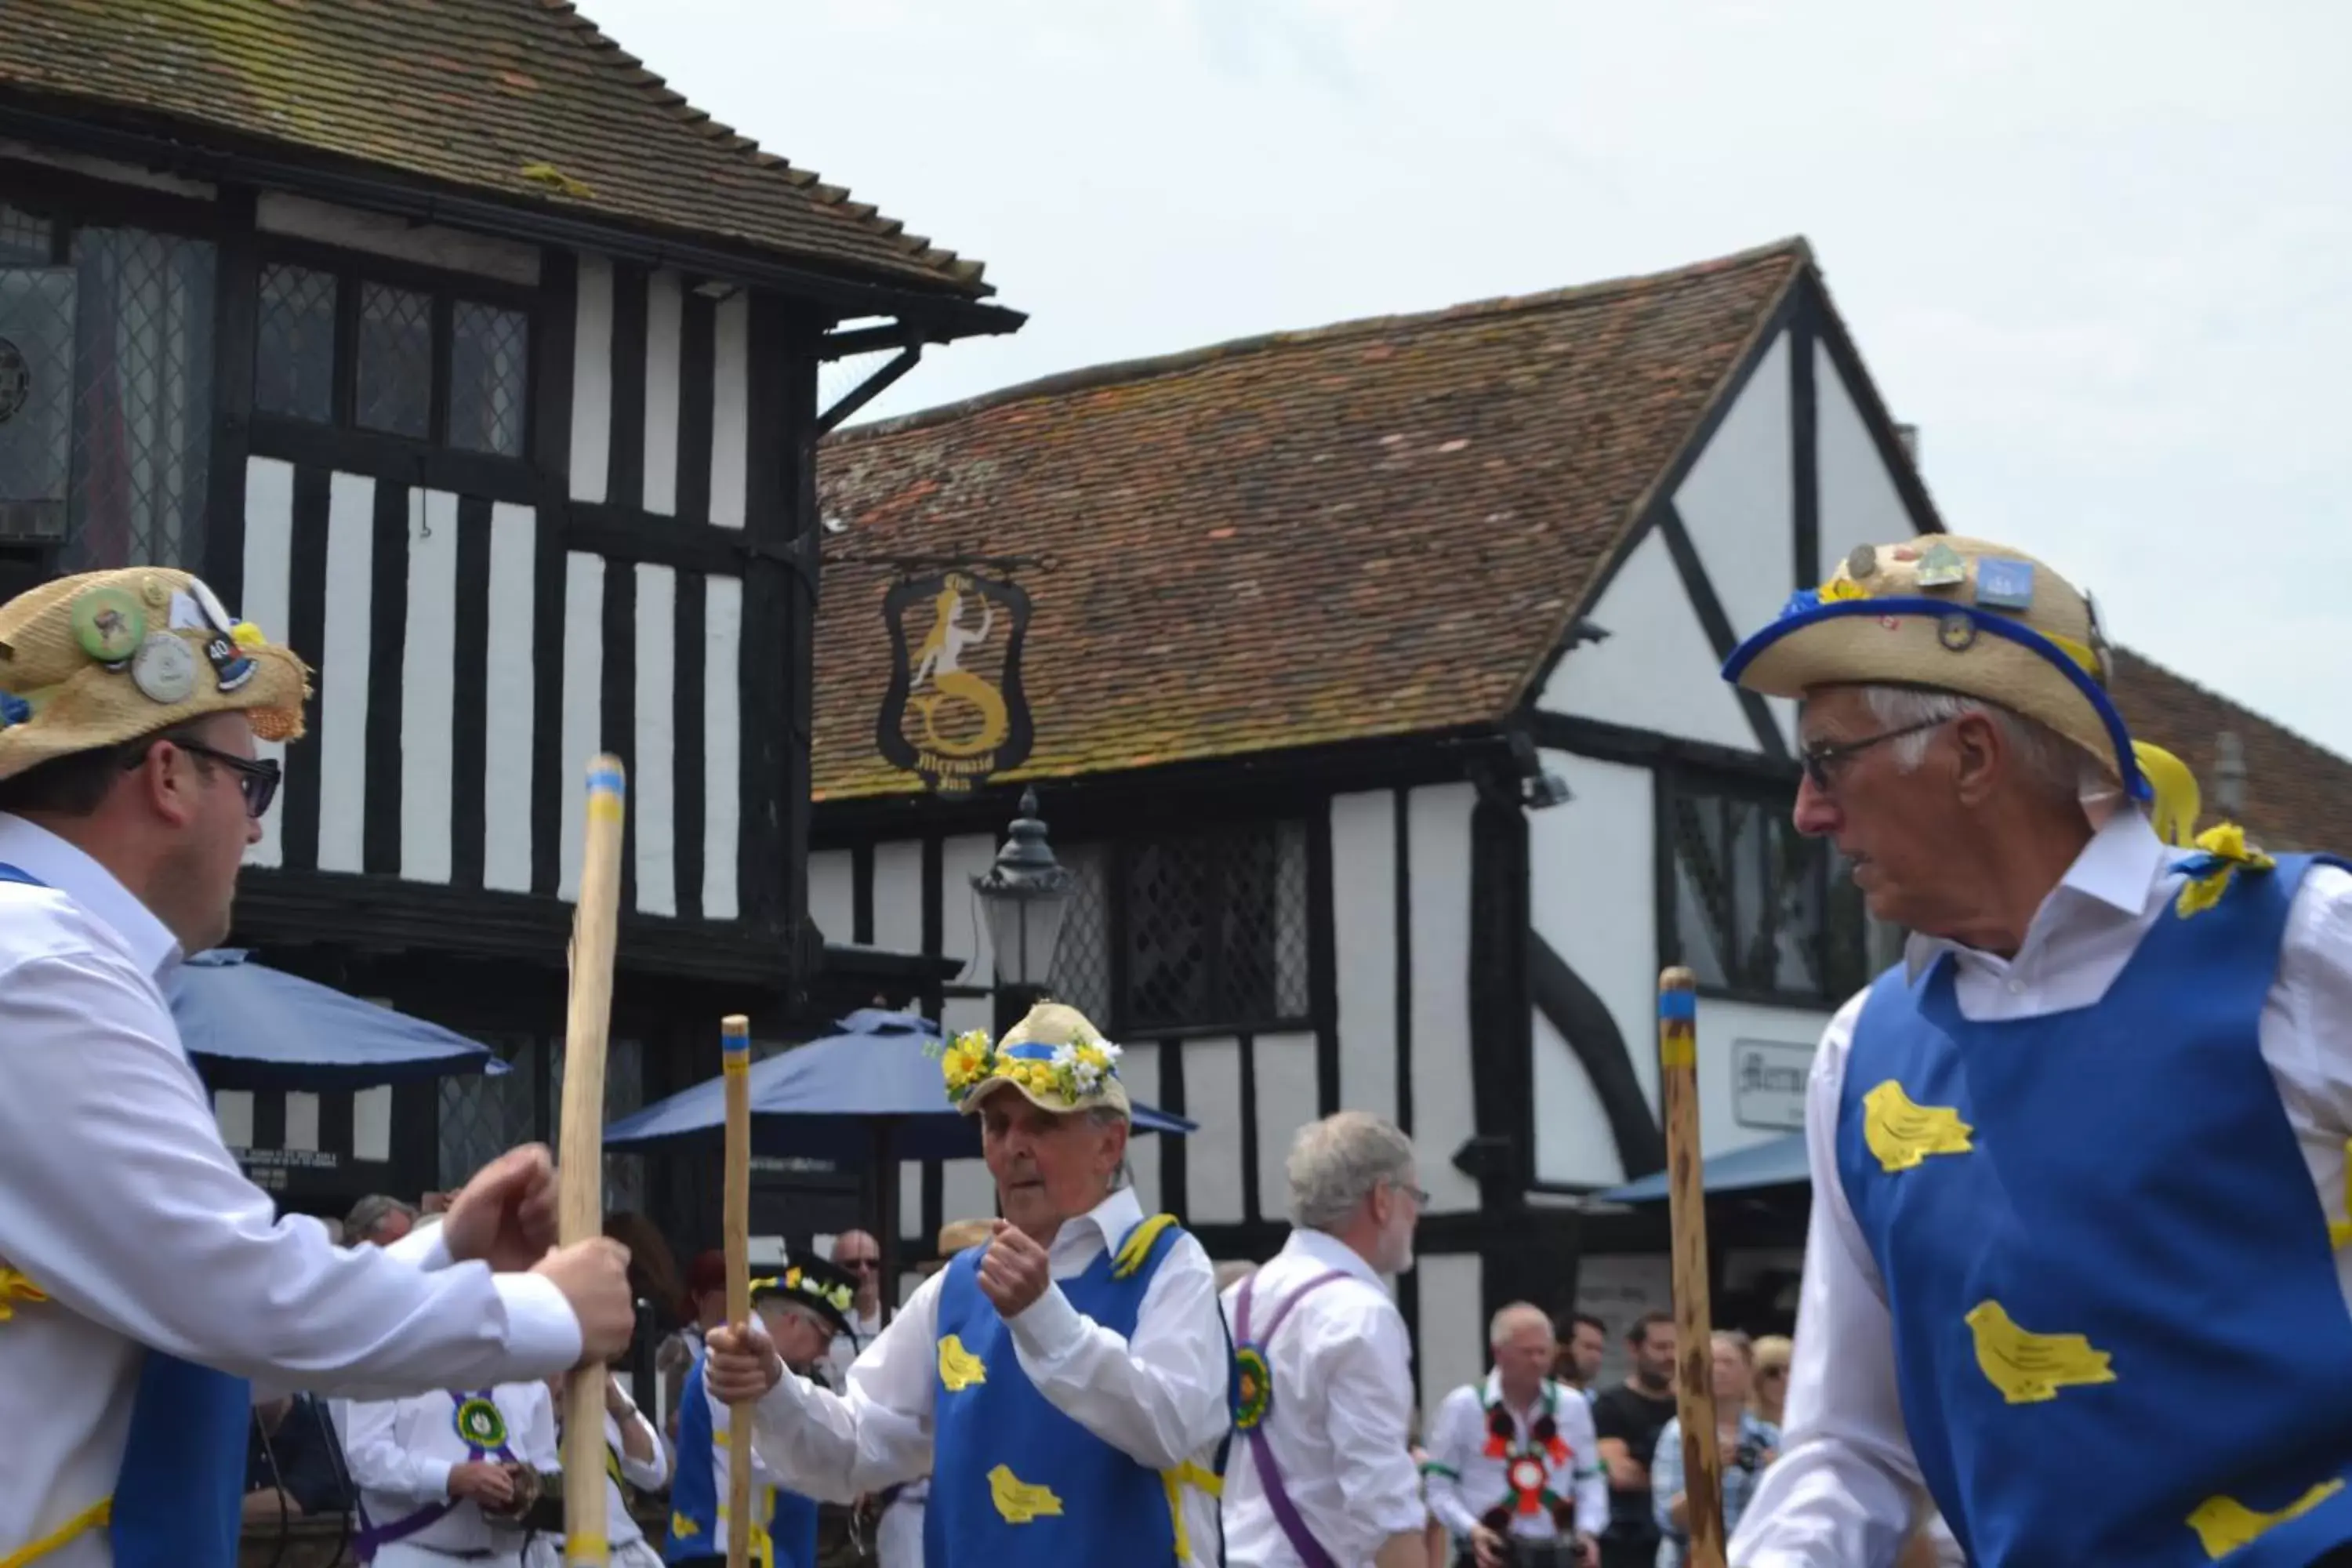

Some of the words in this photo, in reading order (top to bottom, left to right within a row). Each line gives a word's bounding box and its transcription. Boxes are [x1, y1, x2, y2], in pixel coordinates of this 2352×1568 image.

[209, 640, 228, 659] 40
[918, 750, 995, 777] Mermaid
[936, 777, 971, 791] Inn
